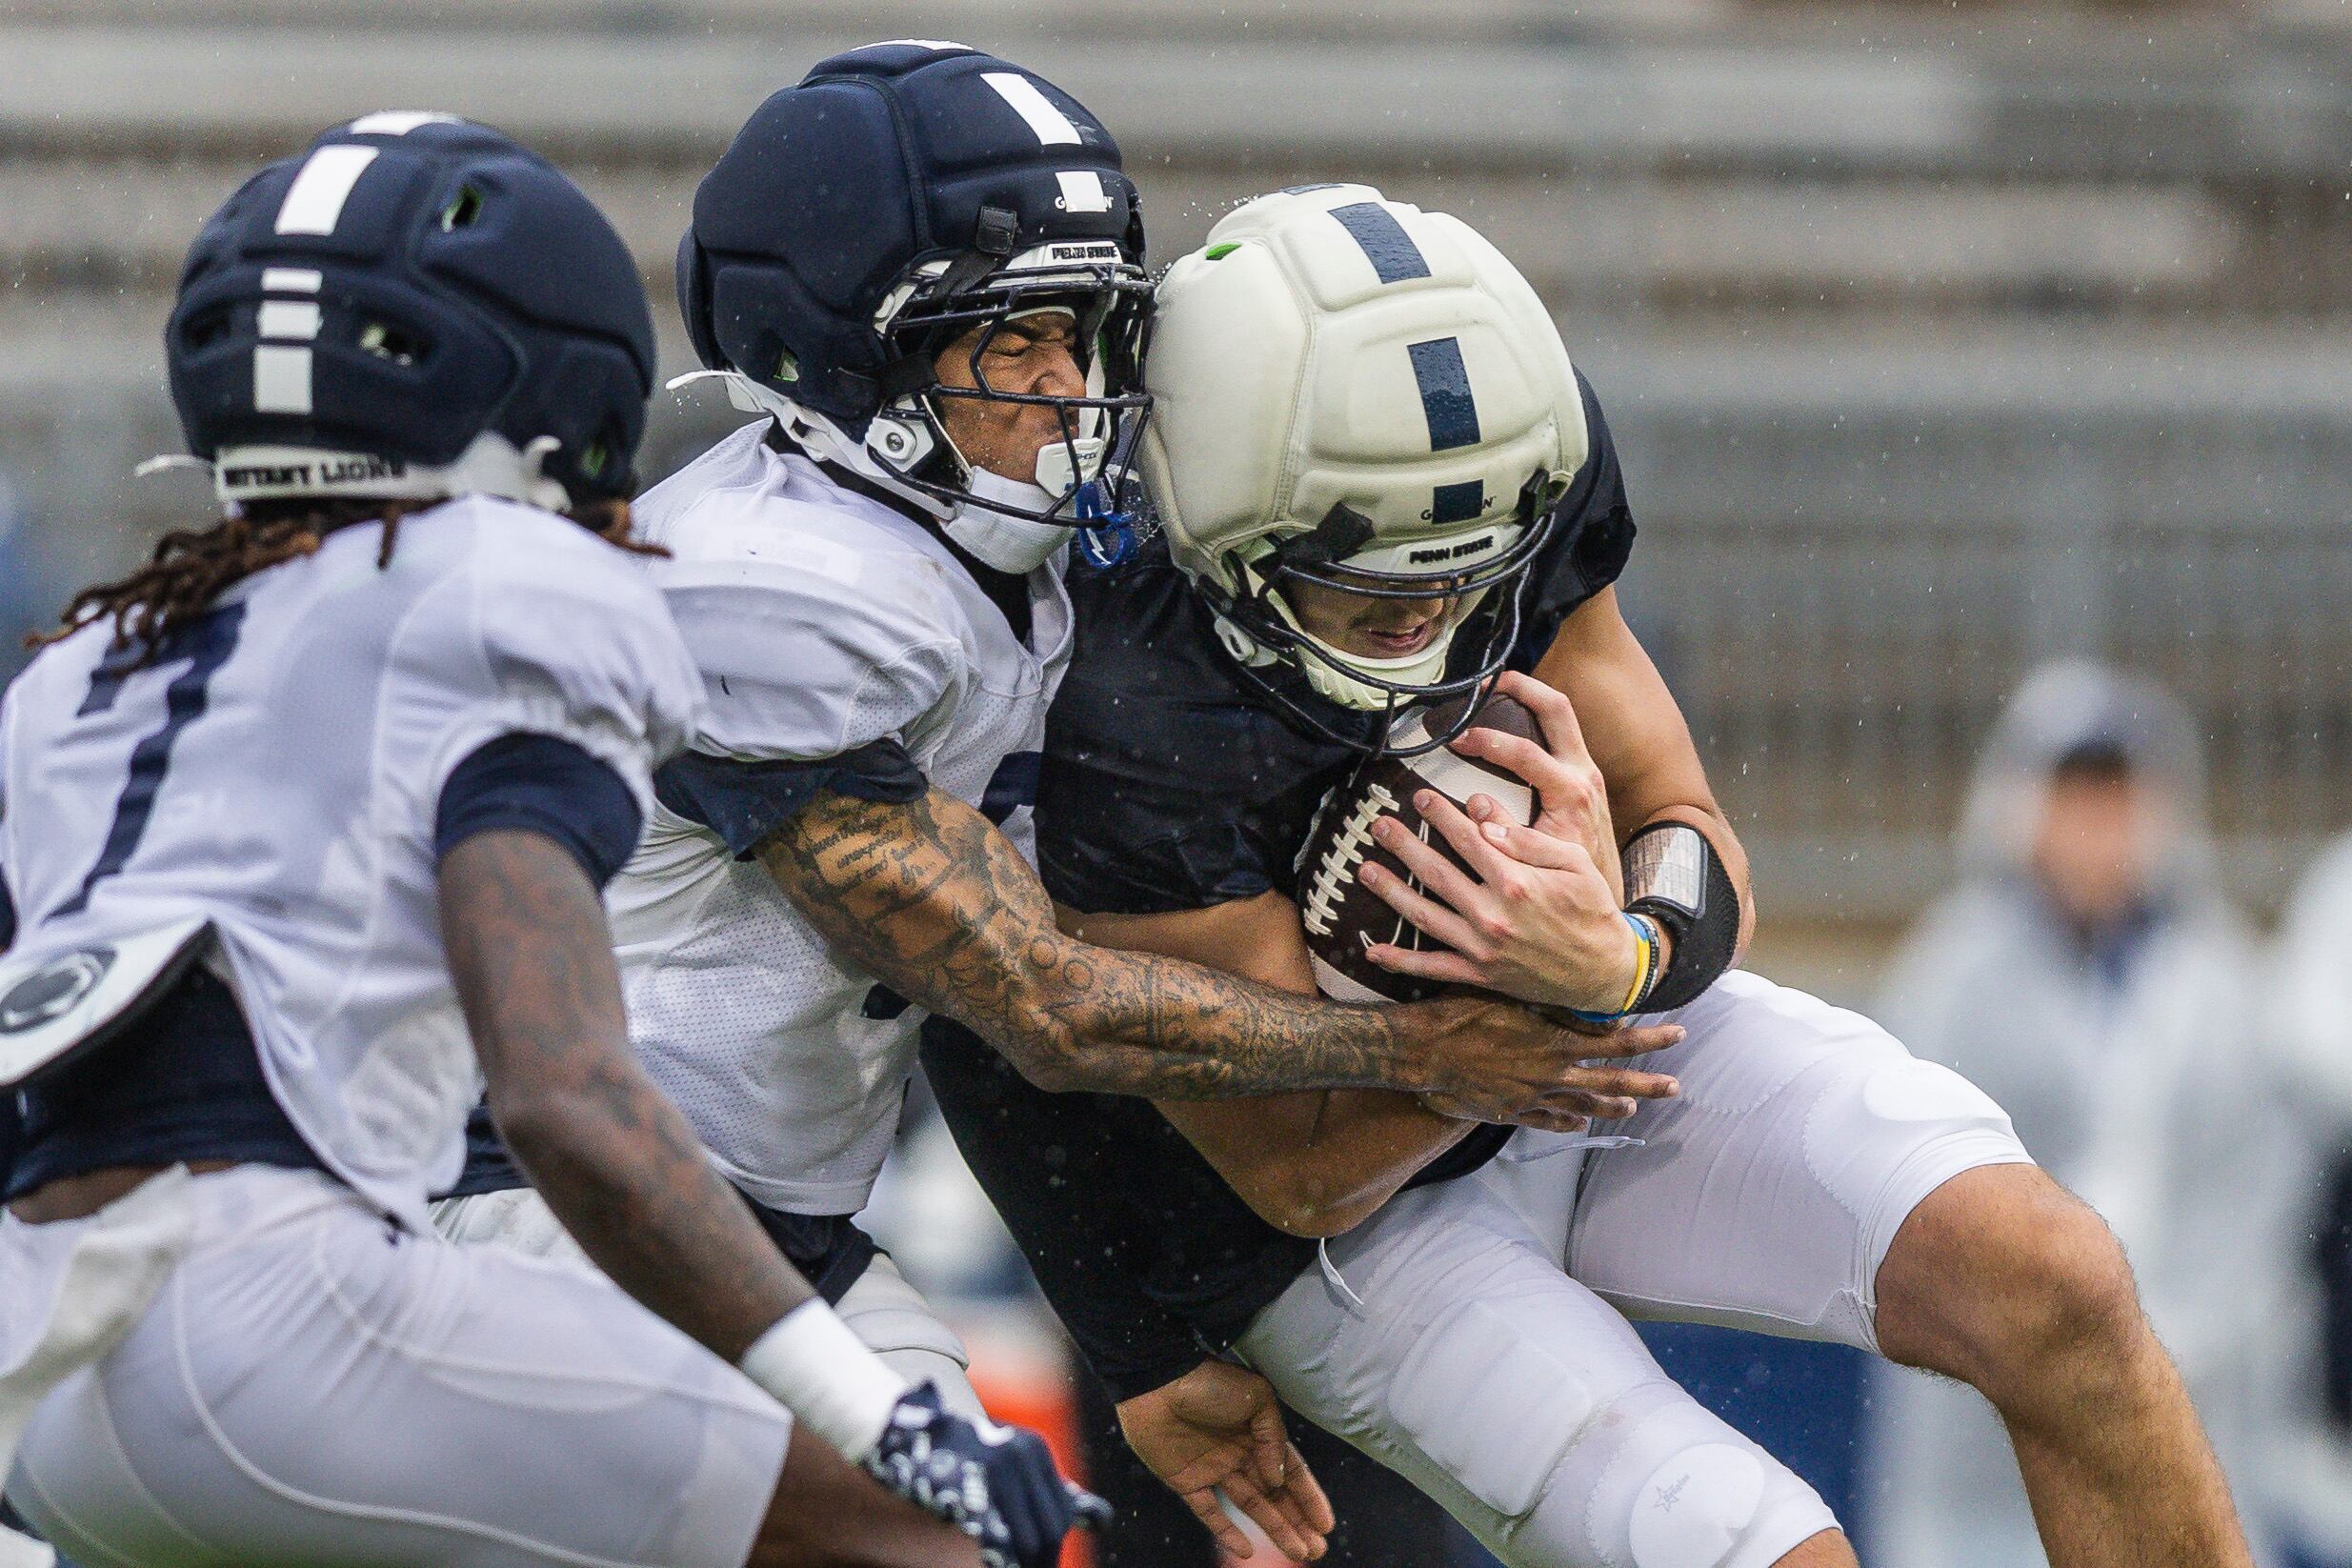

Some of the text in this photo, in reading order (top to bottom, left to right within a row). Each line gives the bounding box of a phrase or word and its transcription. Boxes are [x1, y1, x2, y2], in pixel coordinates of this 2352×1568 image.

[1051, 245, 1118, 260] PENN STATE
[1409, 534, 1495, 565] PENN STATE
